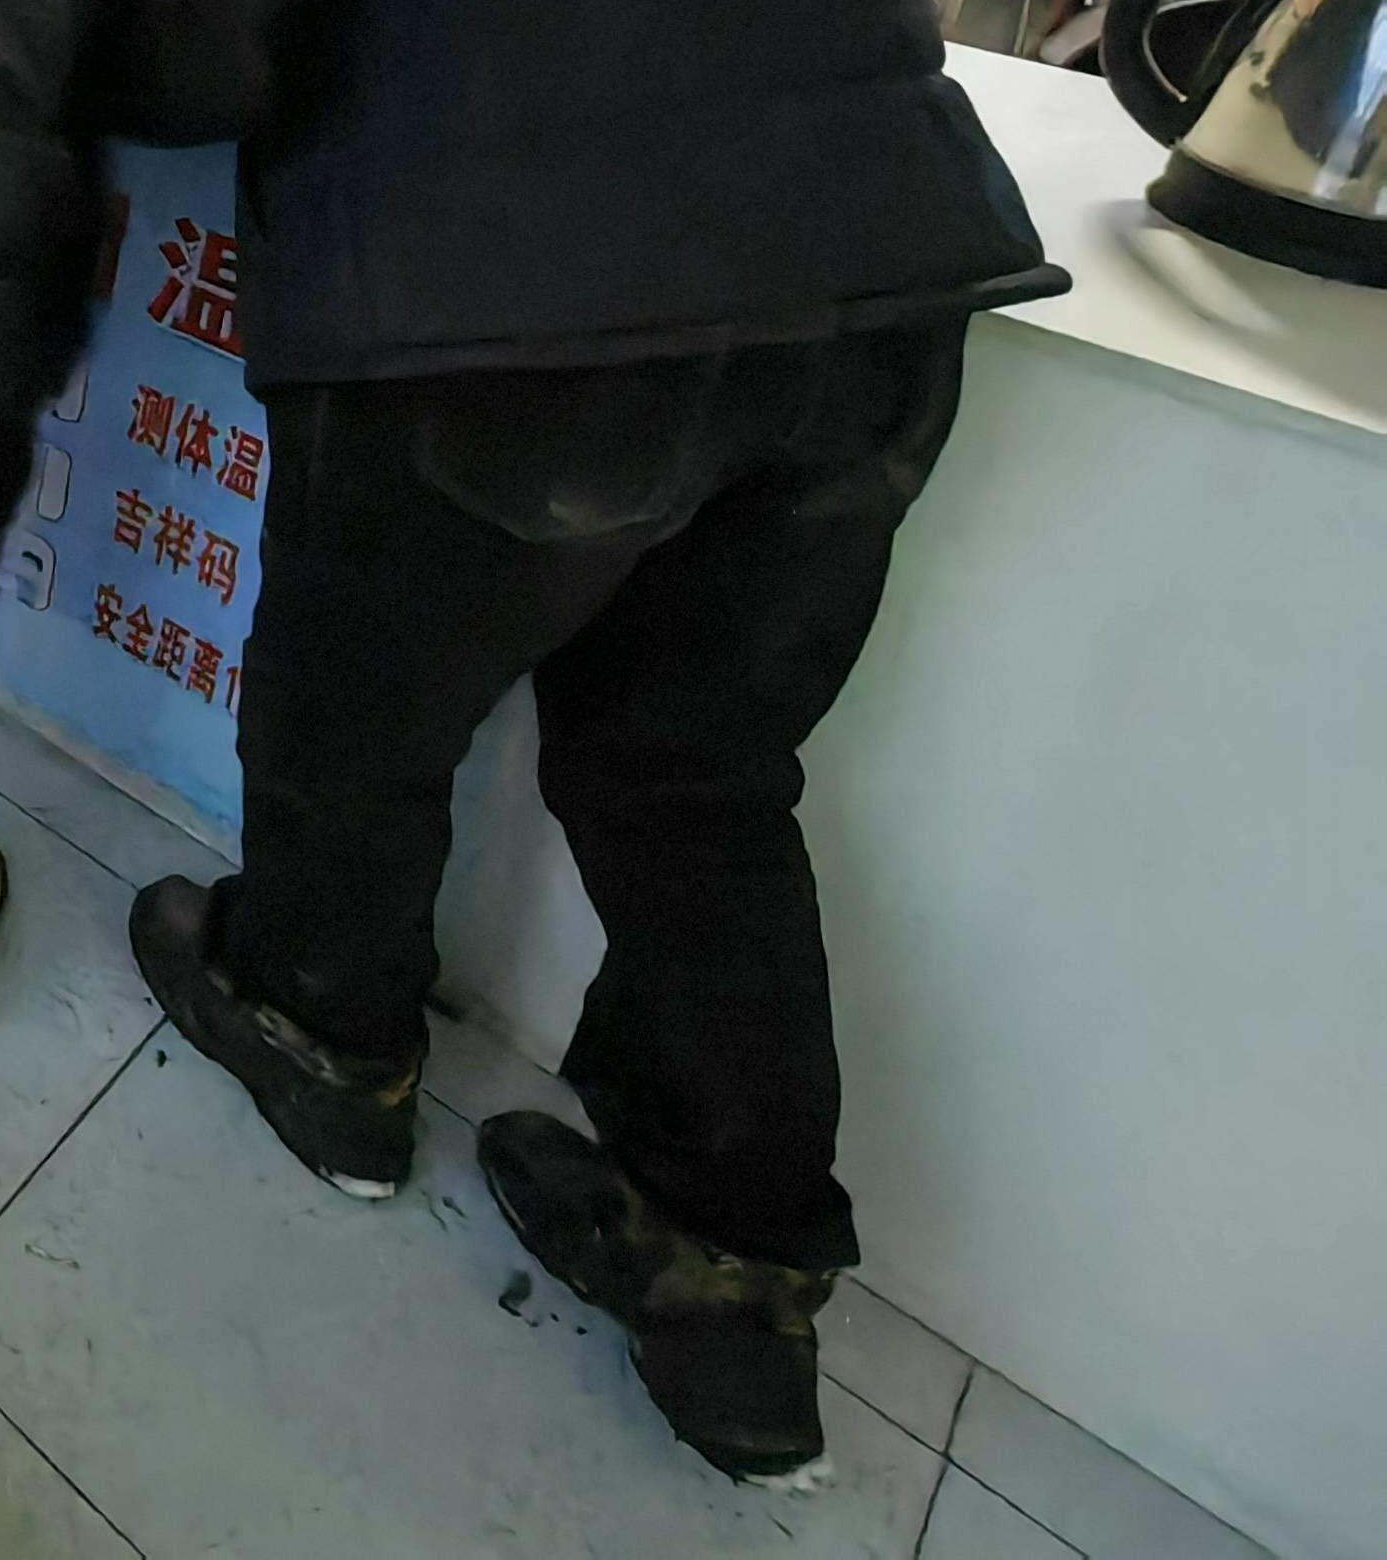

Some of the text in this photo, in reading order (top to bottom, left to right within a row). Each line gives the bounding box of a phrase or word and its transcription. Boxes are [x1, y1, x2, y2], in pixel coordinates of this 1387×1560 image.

[127, 383, 263, 503] 测体温
[112, 489, 241, 607] 吉祥码
